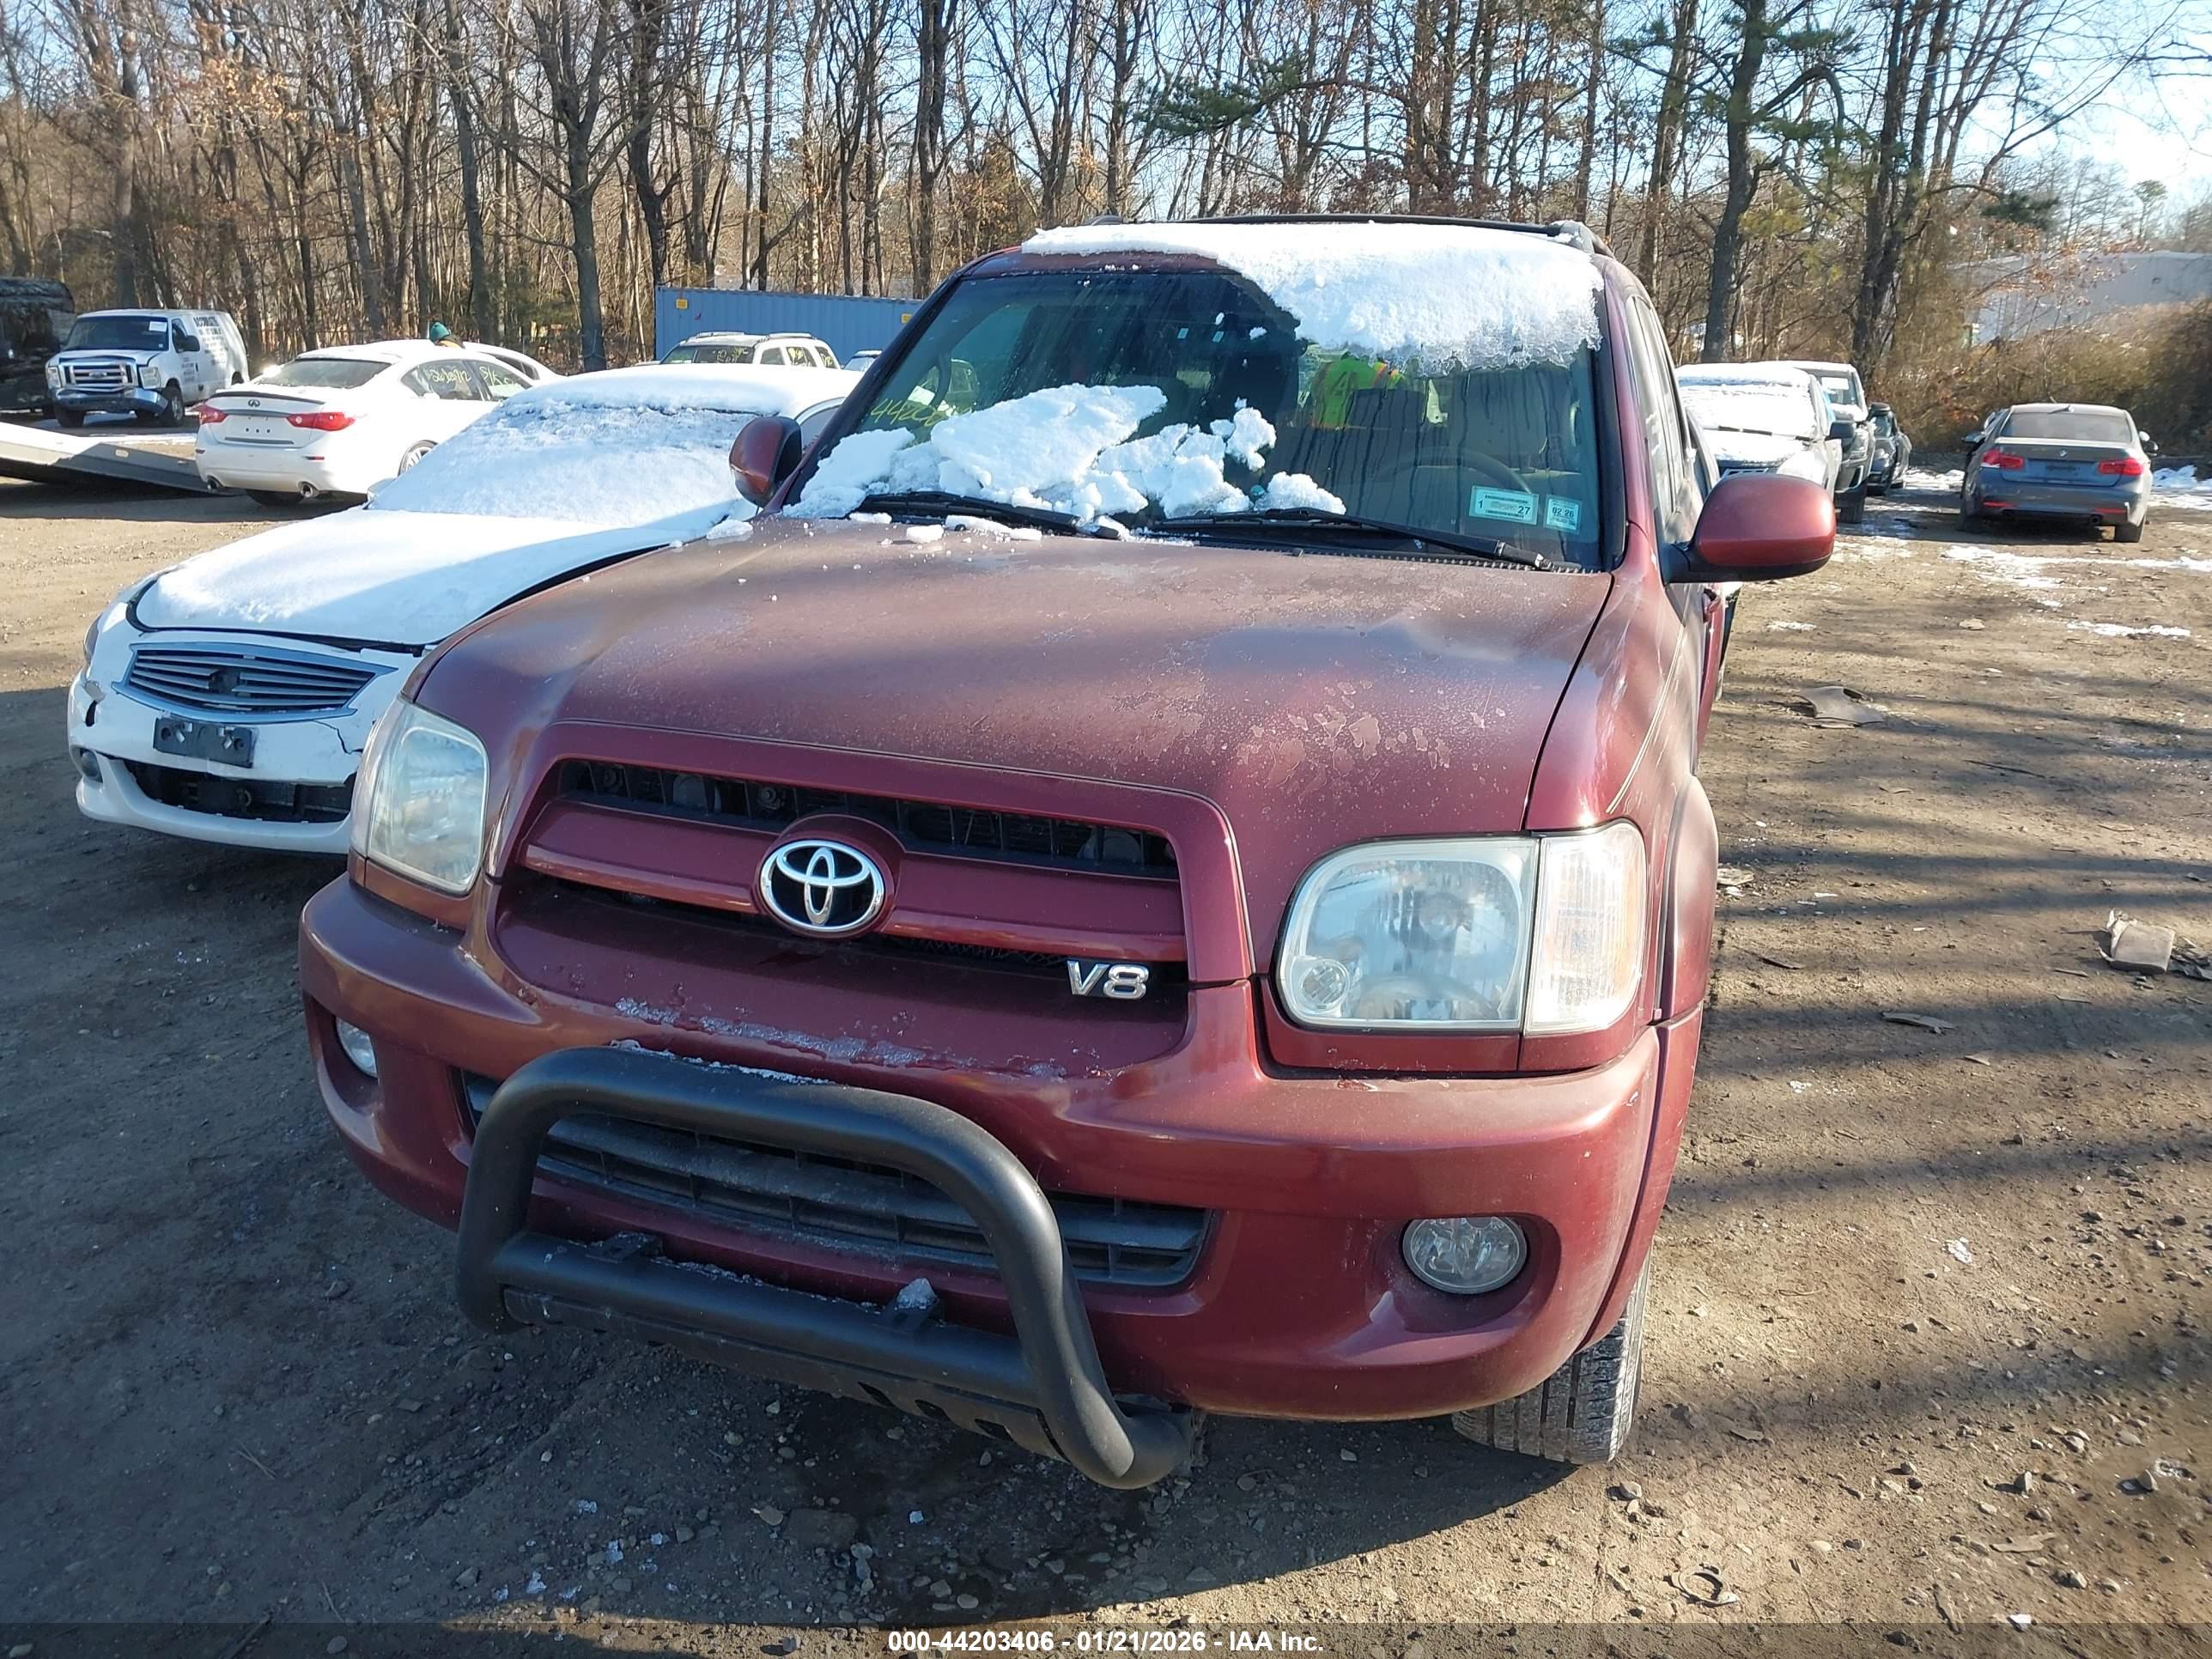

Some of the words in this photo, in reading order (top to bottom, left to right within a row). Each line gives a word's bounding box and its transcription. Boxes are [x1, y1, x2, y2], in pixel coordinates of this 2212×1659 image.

[1478, 500, 1484, 508] 1
[1517, 506, 1531, 515] 27
[1066, 959, 1150, 1000] V8
